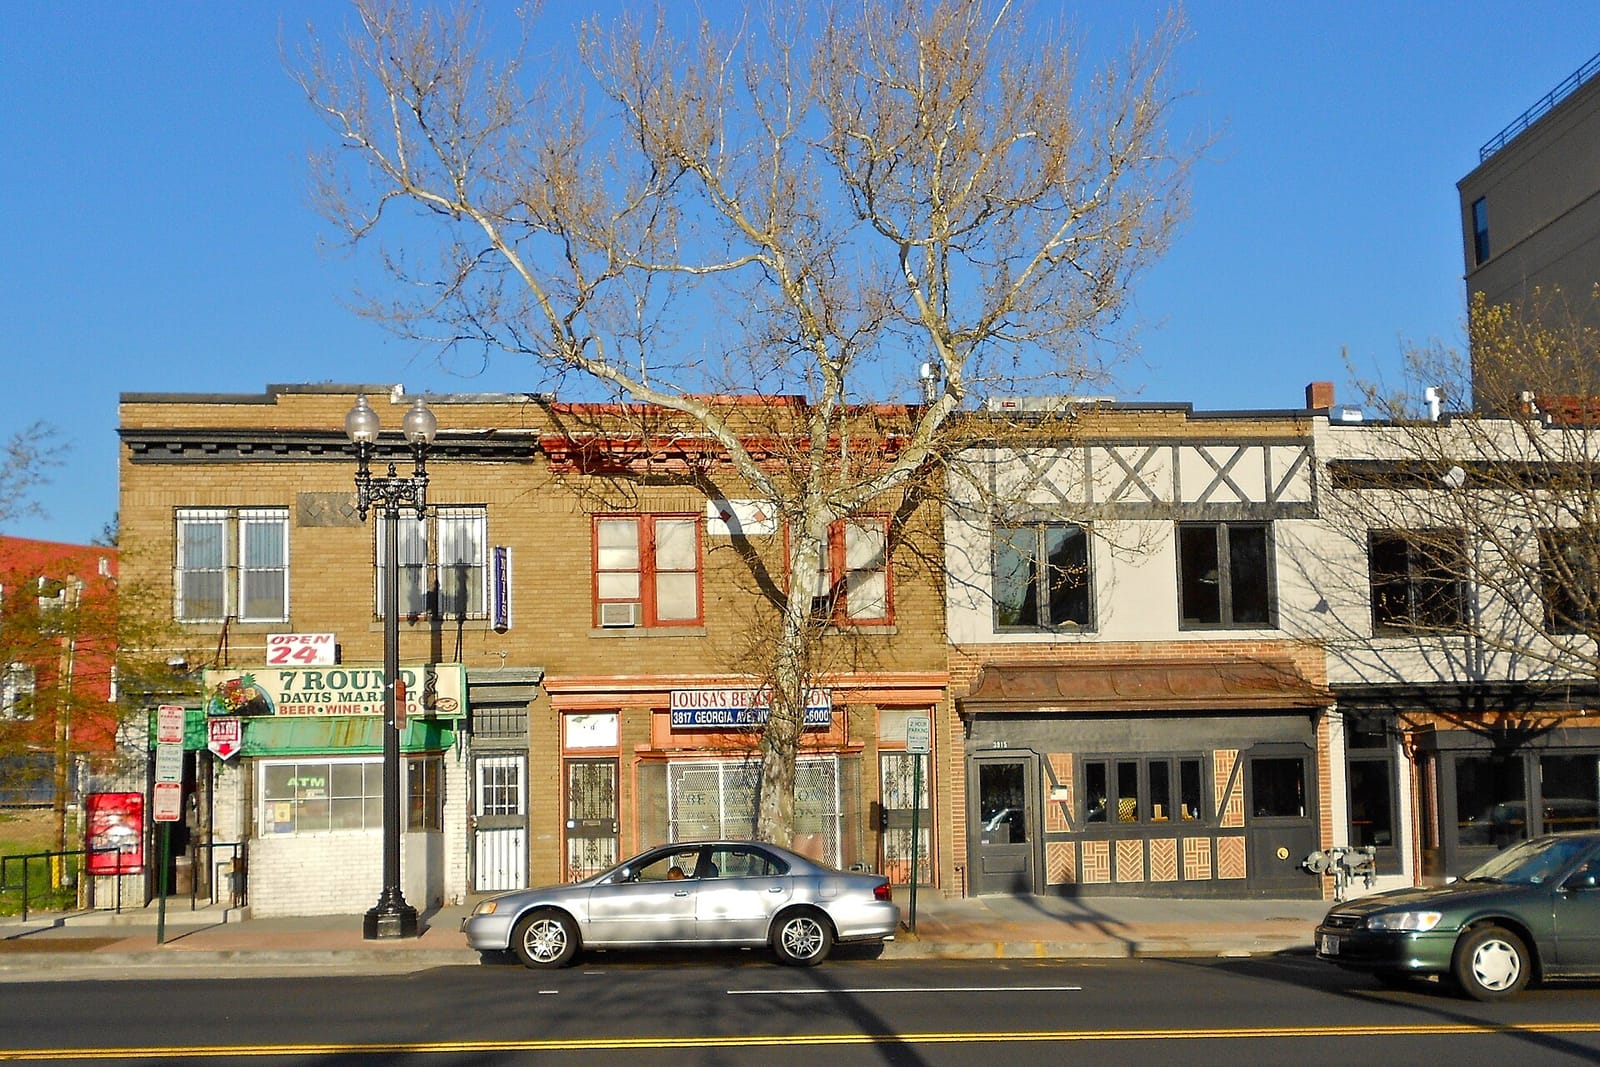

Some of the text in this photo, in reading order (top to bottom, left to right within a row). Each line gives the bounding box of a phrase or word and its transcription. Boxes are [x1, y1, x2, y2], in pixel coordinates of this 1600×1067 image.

[270, 635, 331, 645] OPEN
[269, 646, 318, 664] 24
[279, 671, 297, 691] 7
[279, 691, 417, 704] DAVIS MART
[673, 691, 726, 708] LOUISA'S
[731, 691, 774, 707] BEAUT
[279, 704, 316, 715] BEER
[325, 704, 361, 715] WINE
[673, 712, 692, 724] 3817
[695, 711, 733, 724] GEORGIA
[212, 722, 237, 735] ATM
[287, 777, 325, 787] ATM
